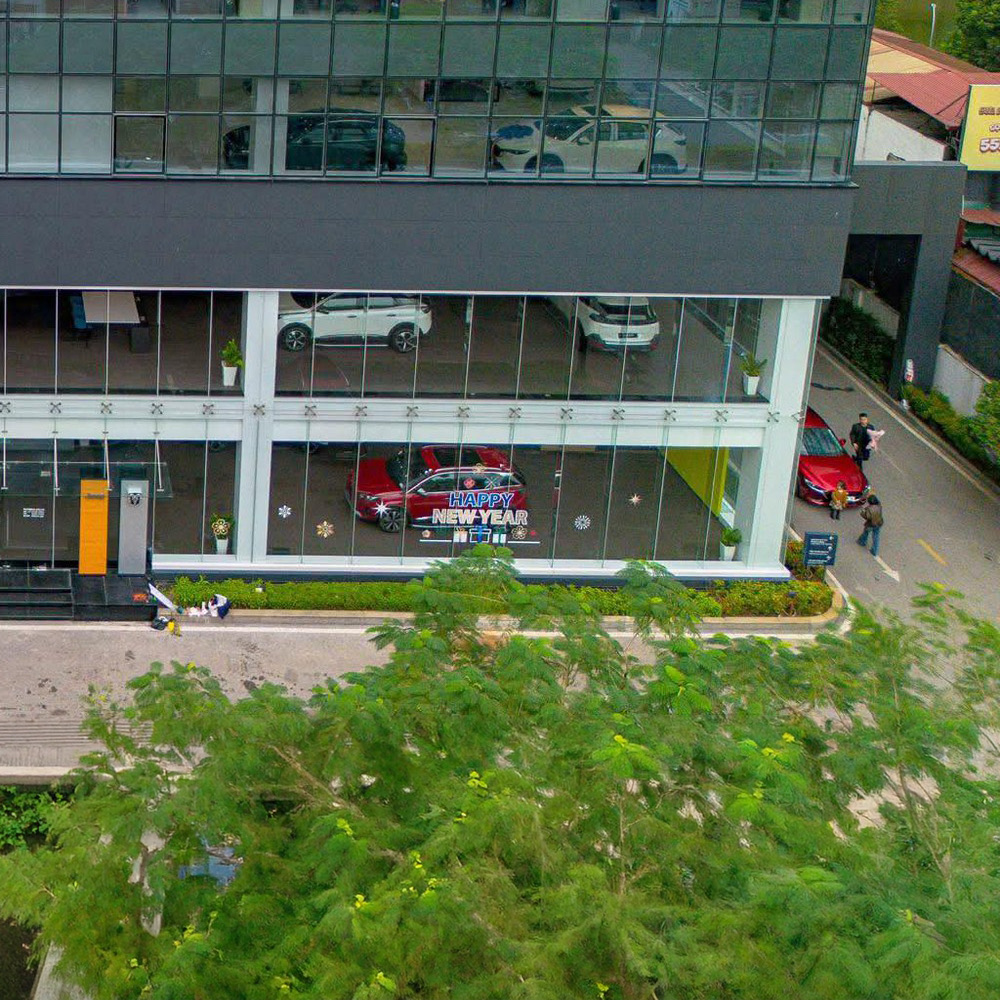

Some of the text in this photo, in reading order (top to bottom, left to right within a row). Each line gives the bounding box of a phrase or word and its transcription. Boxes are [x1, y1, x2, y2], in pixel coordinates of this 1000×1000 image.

[449, 491, 514, 507] HAPPY
[432, 508, 528, 525] NEW YEAR
